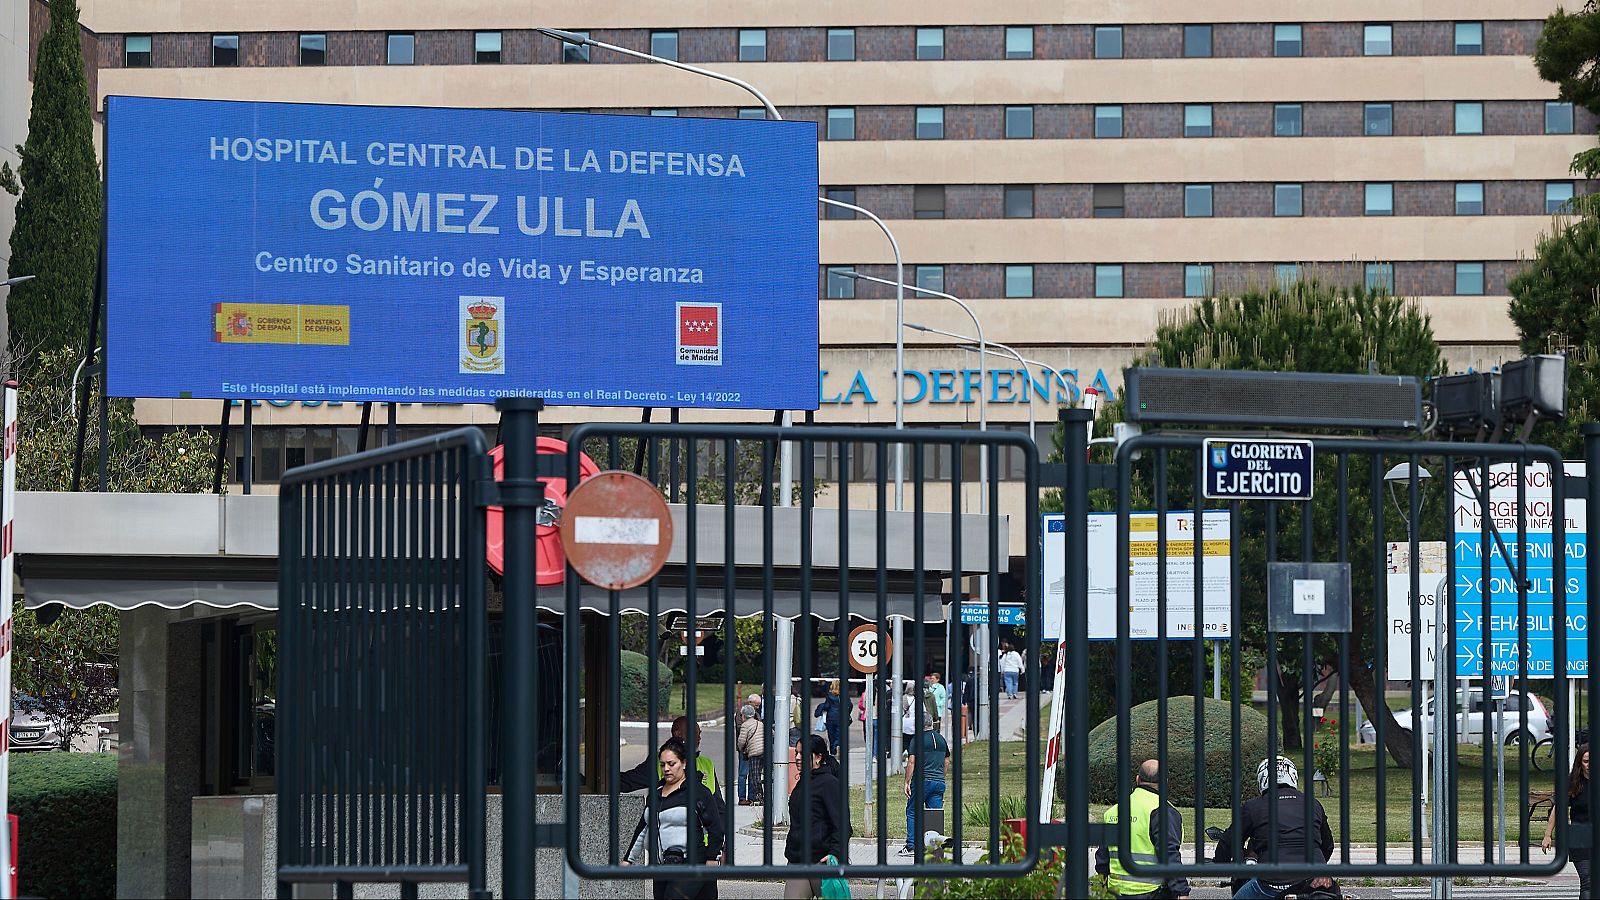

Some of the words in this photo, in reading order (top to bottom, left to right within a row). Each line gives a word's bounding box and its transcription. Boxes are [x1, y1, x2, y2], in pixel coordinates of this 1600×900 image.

[210, 136, 357, 165] HOSPITAL
[366, 142, 506, 170] CENTRAL
[515, 147, 553, 171] DE
[564, 148, 601, 173] LA
[609, 150, 746, 178] DEFENSA
[309, 176, 500, 235] GÓMEZ
[516, 195, 651, 239] ULLA
[255, 251, 338, 274] Centro
[346, 253, 455, 278] Sanitario
[462, 258, 490, 279] de
[498, 257, 551, 280] Vida
[558, 263, 572, 285] y
[580, 259, 703, 287] Esperanza
[222, 382, 248, 393] Este
[250, 382, 298, 395] Hospital
[301, 383, 326, 394] está
[328, 384, 416, 397] implementando
[418, 385, 435, 396] las
[438, 386, 484, 397] medidas
[488, 387, 564, 398] consideradas
[567, 391, 580, 399] en
[583, 389, 594, 399] el
[596, 389, 621, 400] Real
[624, 390, 667, 401] Decreto
[677, 391, 697, 403] Ley
[700, 391, 741, 402] 14/2022
[893, 368, 1114, 404] DEFENSA
[1230, 444, 1304, 460] GLORIETA
[1247, 460, 1271, 471] DEL
[1216, 471, 1301, 494] EJERCITO
[858, 640, 878, 658] 30
[1536, 660, 1552, 671] DE
